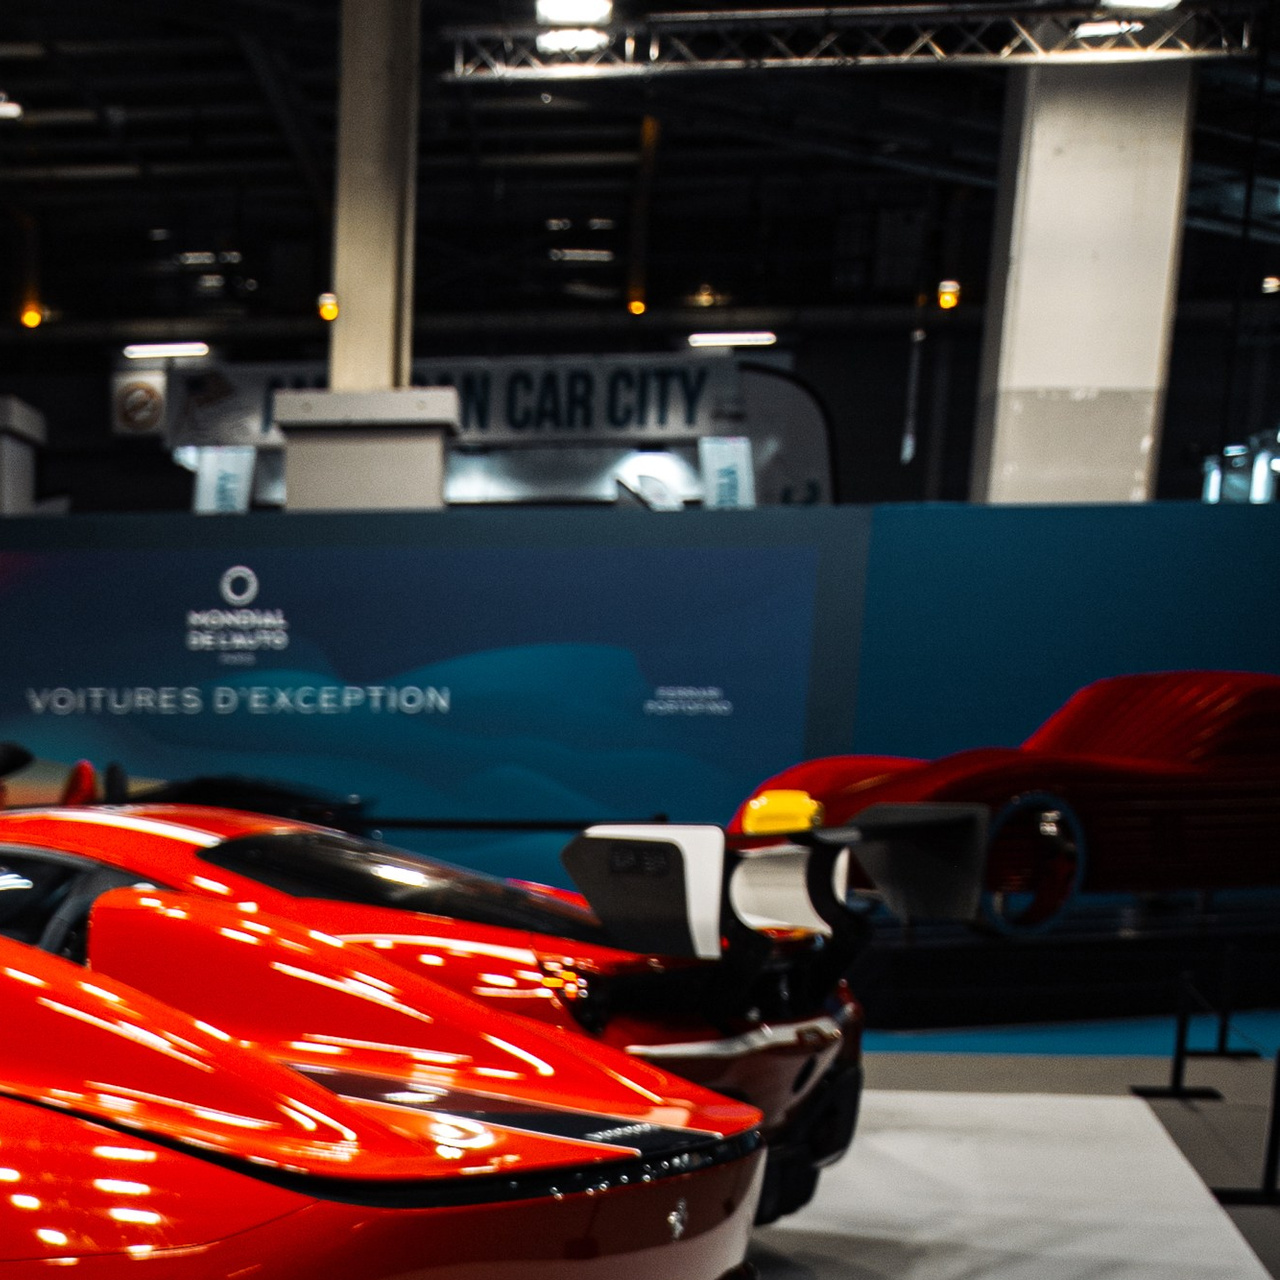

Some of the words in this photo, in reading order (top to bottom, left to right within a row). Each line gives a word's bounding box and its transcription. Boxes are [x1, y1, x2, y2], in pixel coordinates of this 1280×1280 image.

[506, 369, 593, 429] CAR
[607, 367, 708, 427] CITY
[26, 686, 203, 715] VOITURES
[212, 685, 451, 715] D'EXCEPTION
